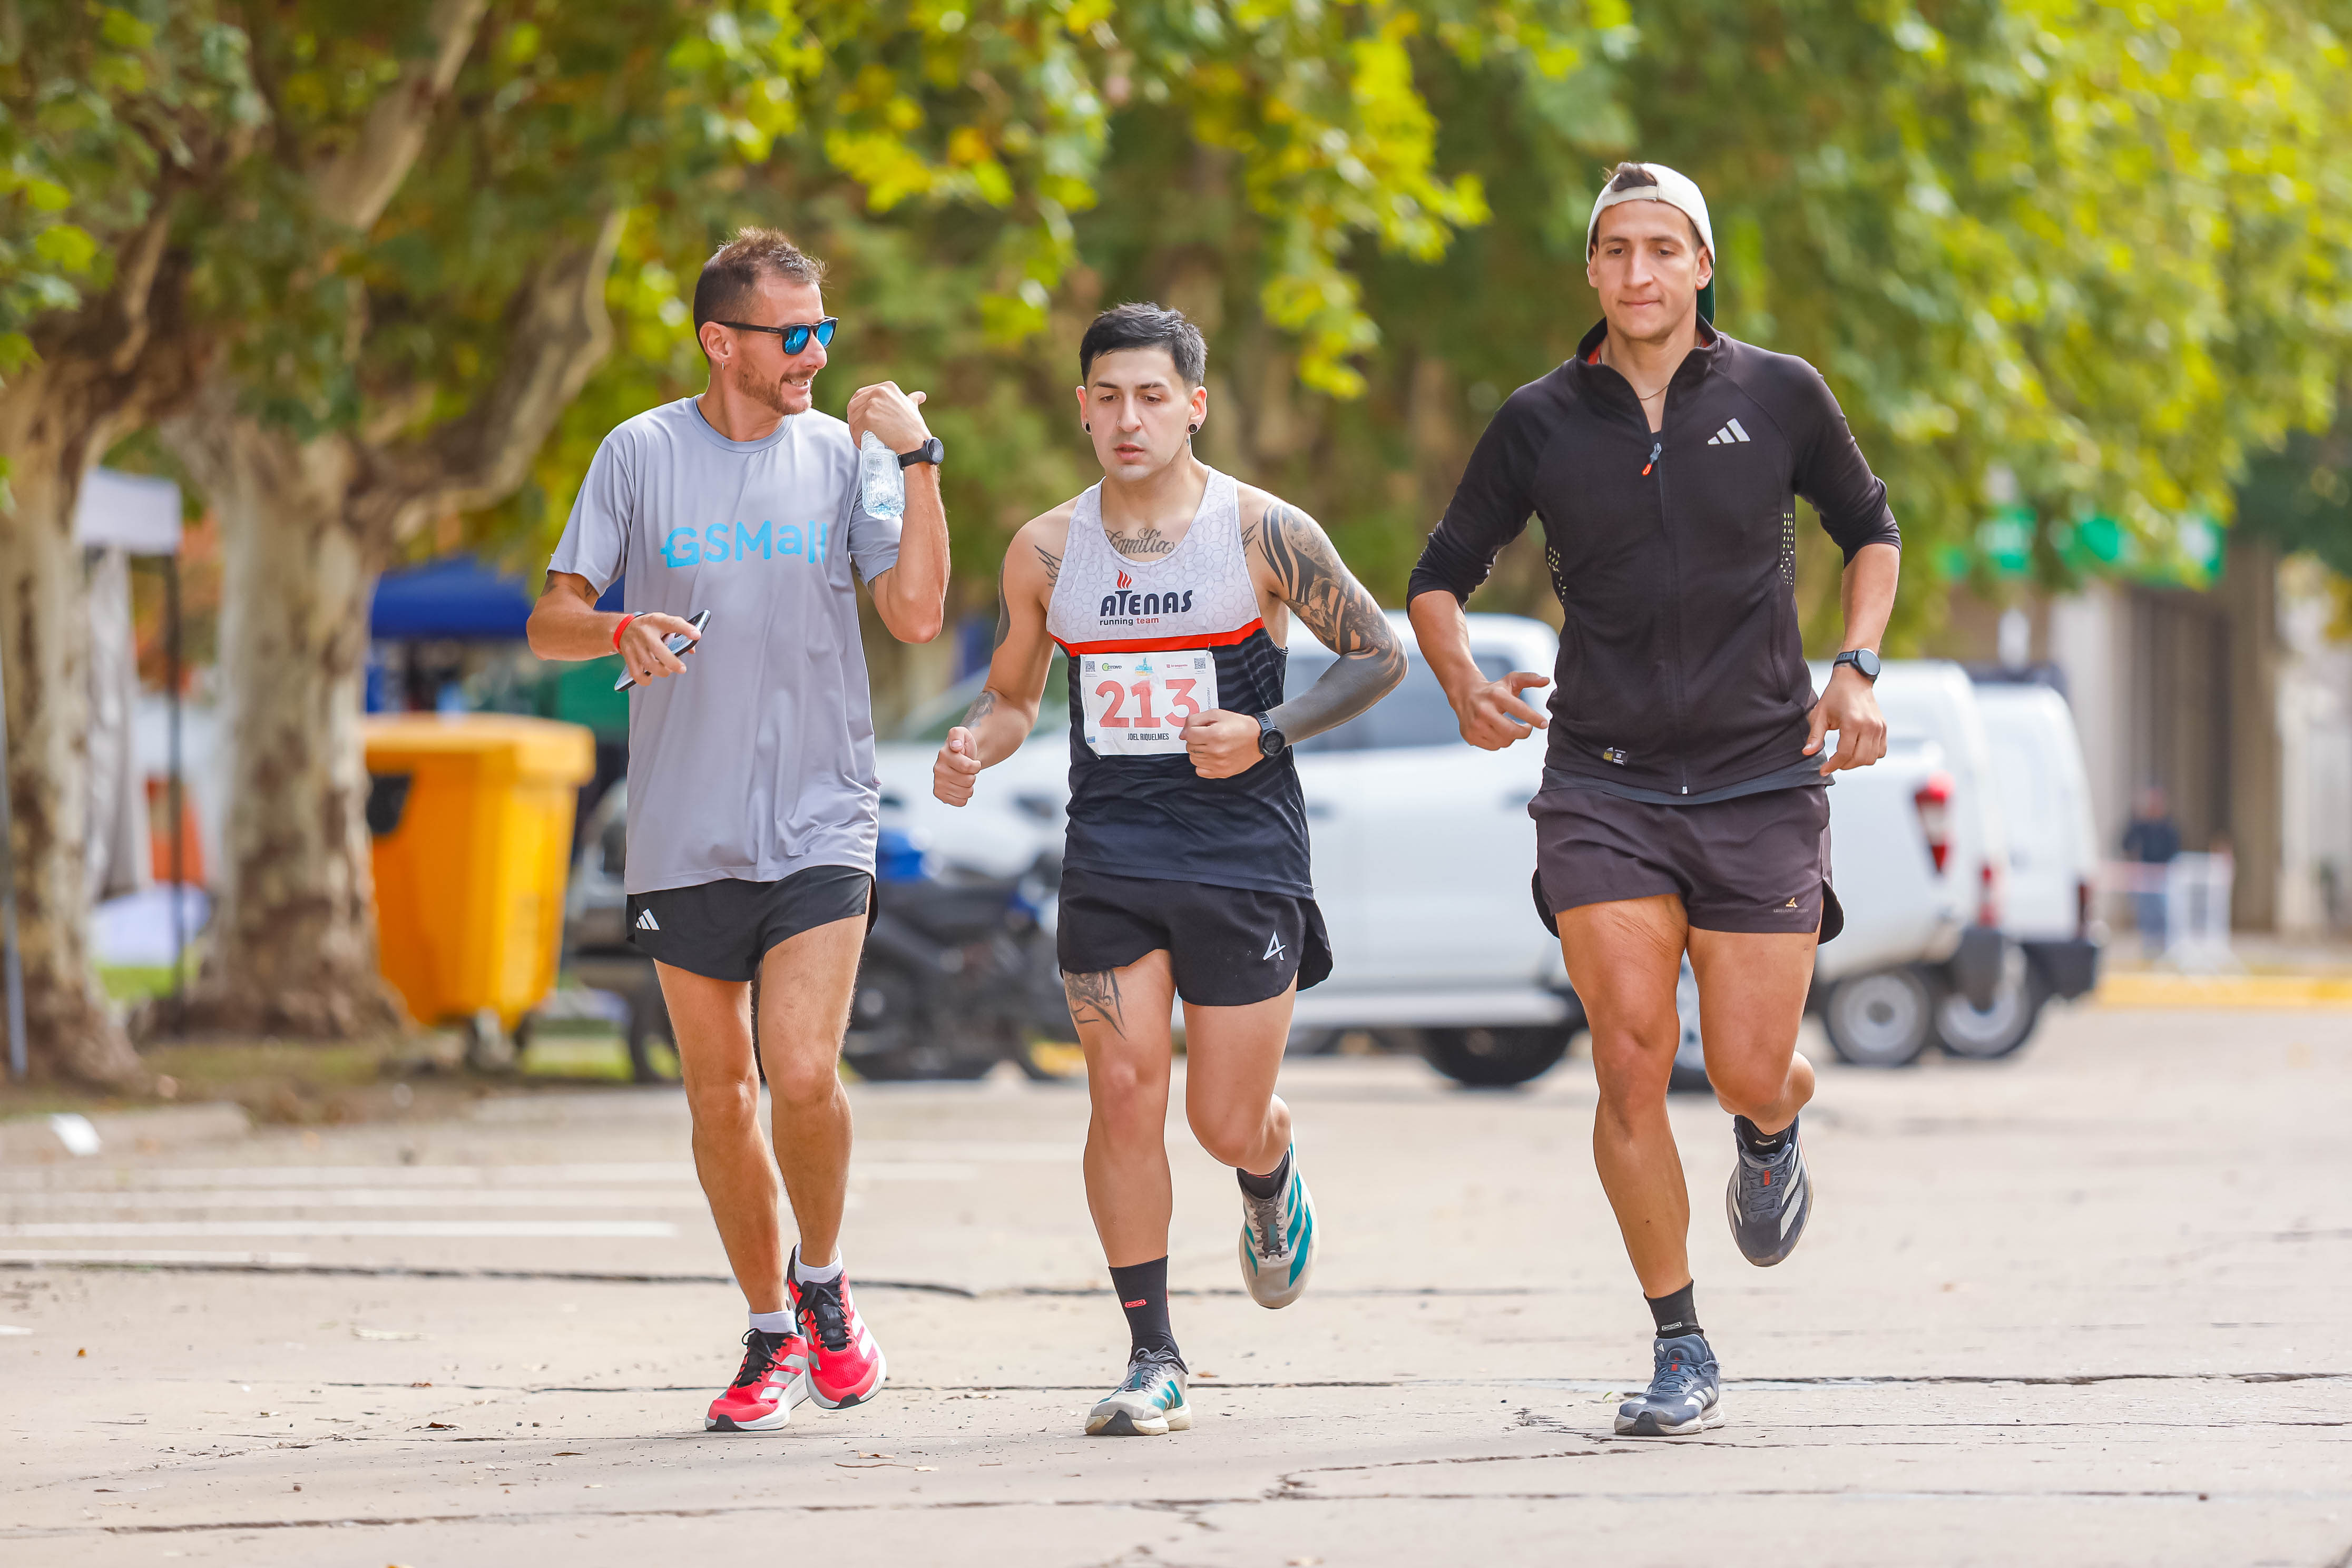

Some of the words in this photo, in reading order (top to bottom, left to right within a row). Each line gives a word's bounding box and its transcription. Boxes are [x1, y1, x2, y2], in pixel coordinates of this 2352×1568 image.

[660, 520, 827, 569] GSMall
[1100, 590, 1193, 616] ATENAS
[1100, 618, 1133, 626] running
[1095, 678, 1200, 728] 213
[1140, 733, 1170, 741] RIQUELMES
